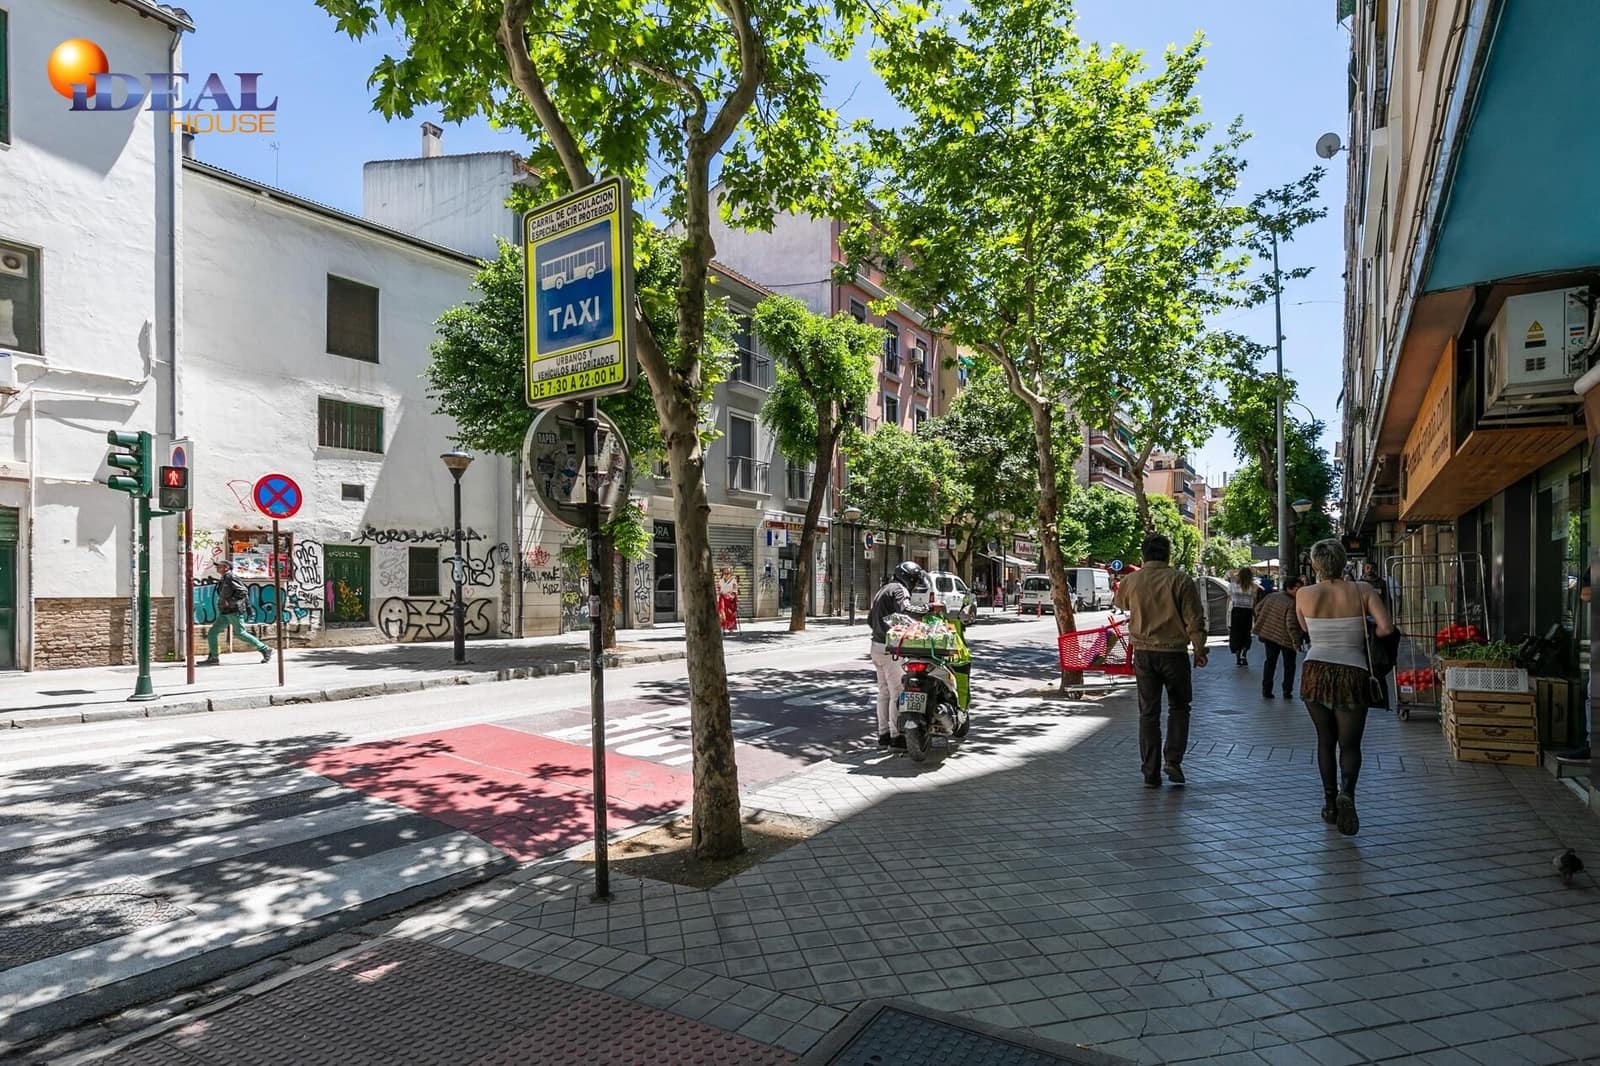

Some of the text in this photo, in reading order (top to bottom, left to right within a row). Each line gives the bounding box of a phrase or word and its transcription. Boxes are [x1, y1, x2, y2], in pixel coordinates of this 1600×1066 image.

[531, 189, 614, 230] CARRIL DE CIRCULACION
[531, 202, 614, 241] ESPECIALMENTE PROTEGIDO
[548, 295, 600, 333] TAXI
[555, 349, 593, 366] URBANOS Y
[571, 354, 615, 373] AUTORIZADOS
[533, 384, 545, 398] DE
[547, 378, 568, 395] 7:30
[570, 377, 577, 390] A
[580, 369, 607, 388] 22:00
